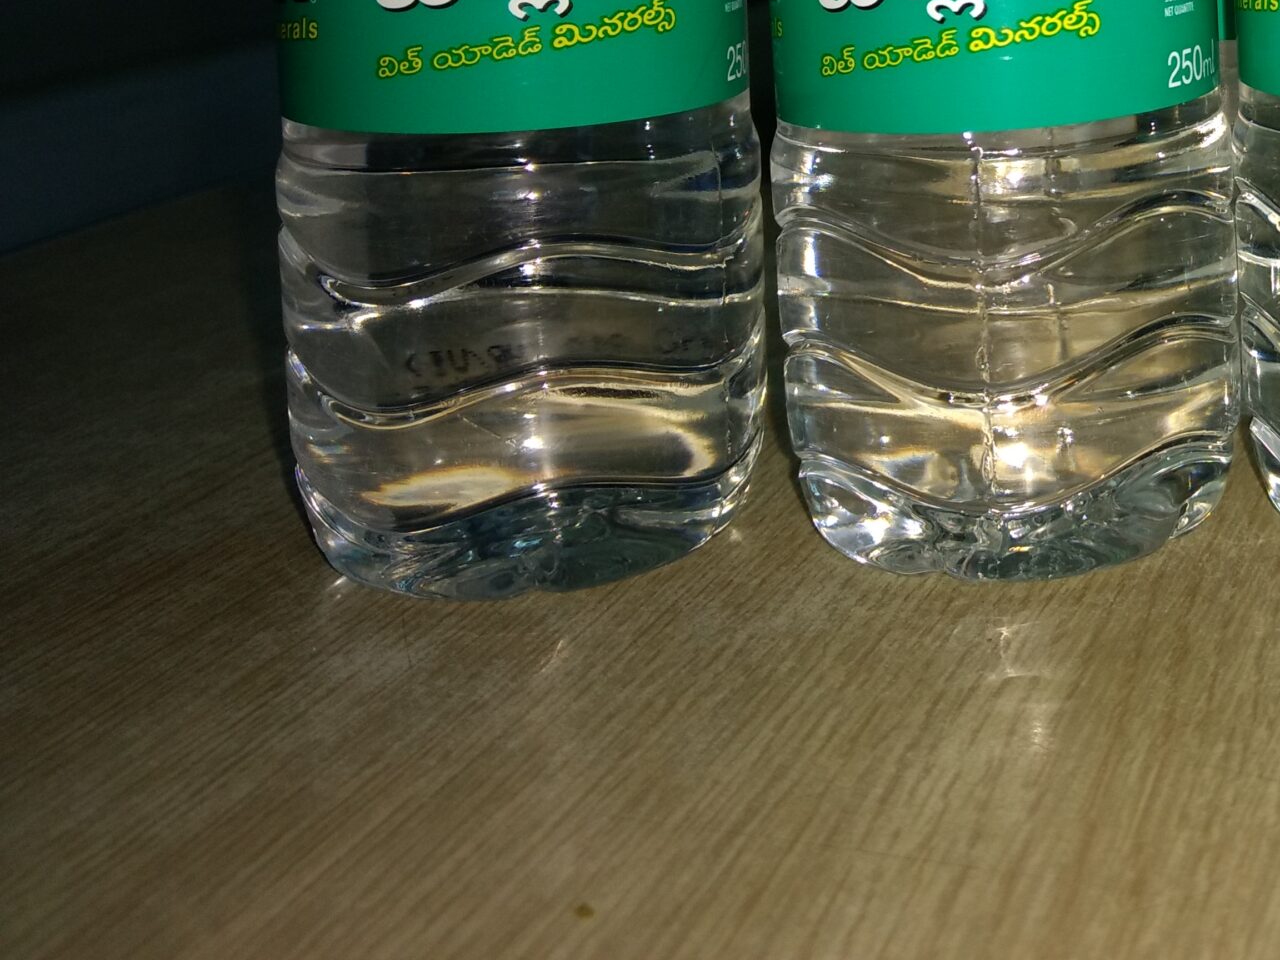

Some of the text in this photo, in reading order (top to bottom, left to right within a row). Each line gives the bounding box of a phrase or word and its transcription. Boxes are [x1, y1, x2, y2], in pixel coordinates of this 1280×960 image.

[377, 46, 423, 79] విత్
[821, 46, 856, 77] విత్
[1167, 38, 1215, 88] 250ml
